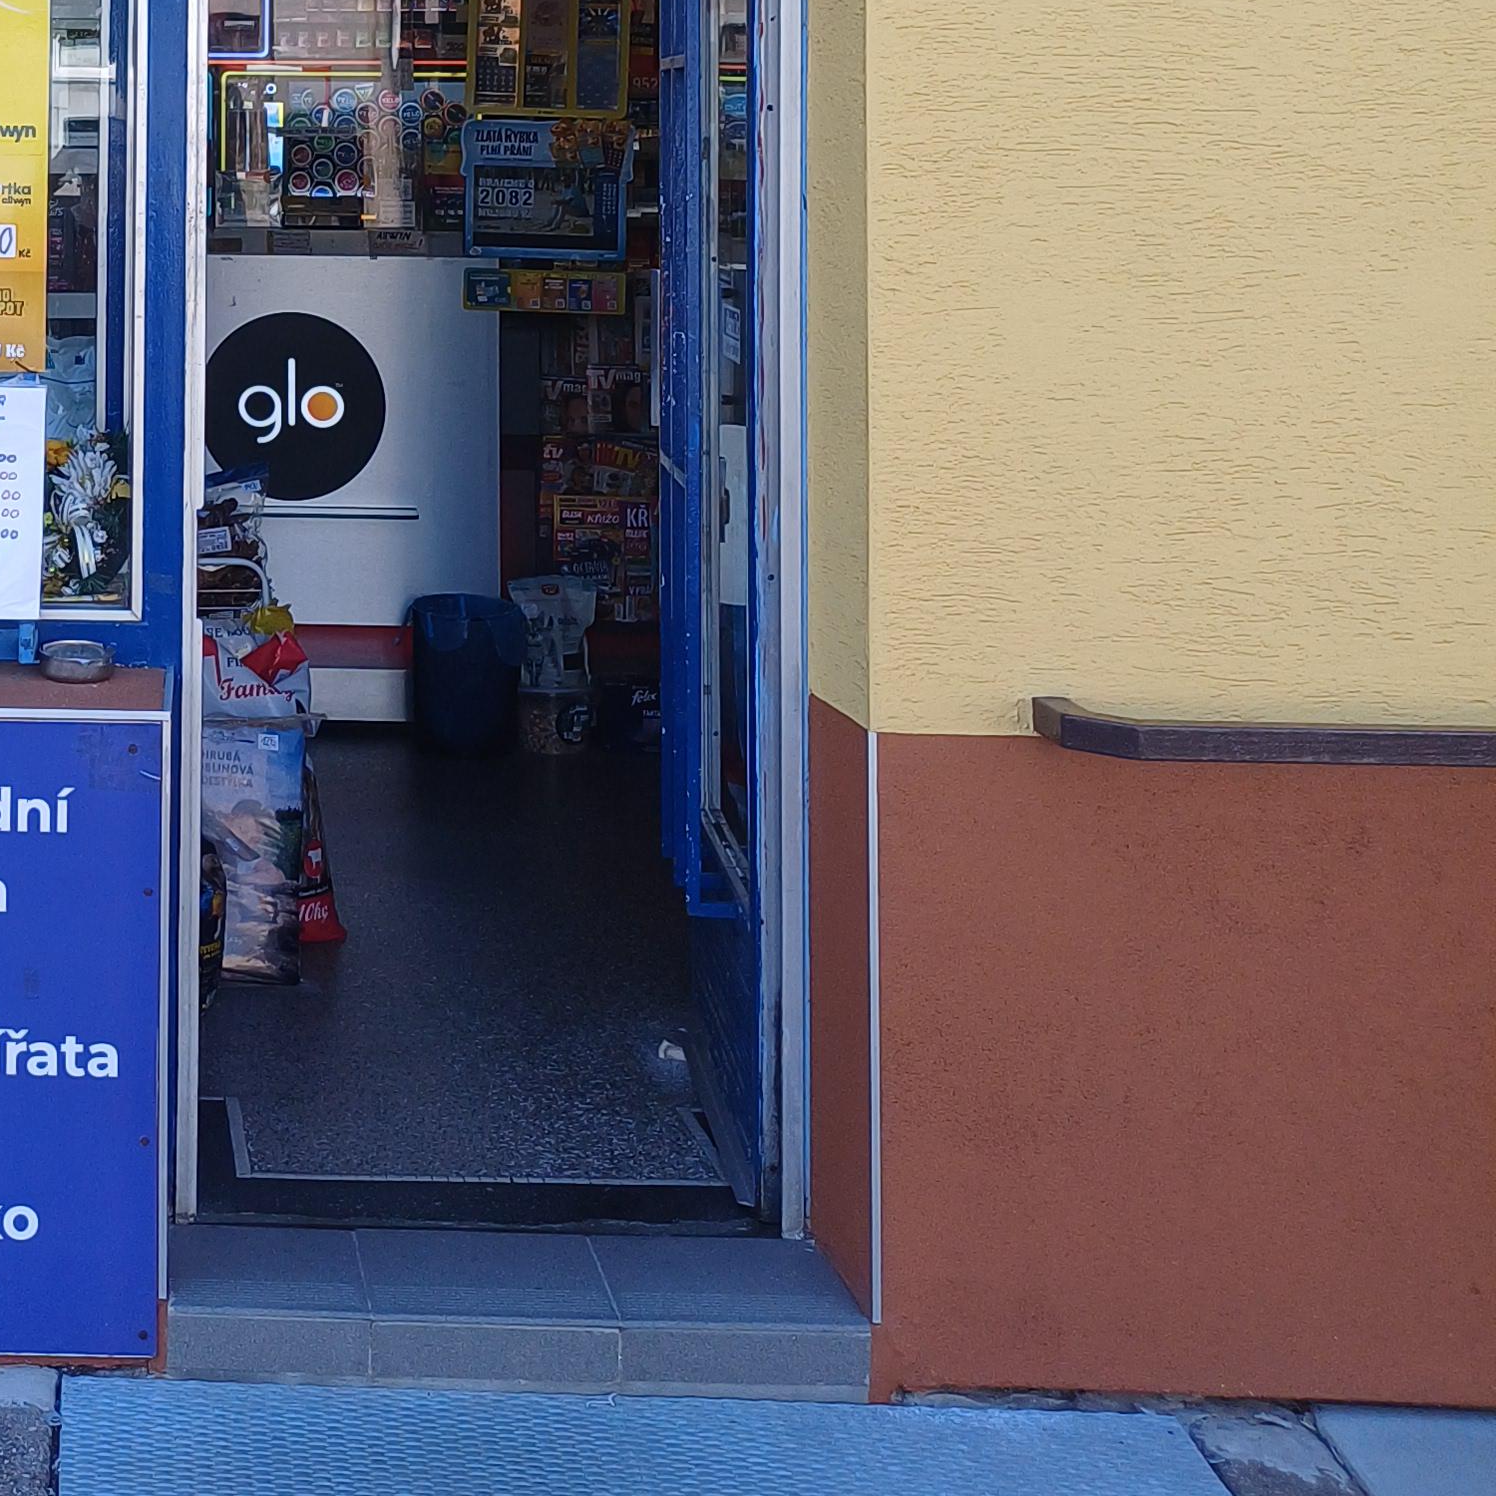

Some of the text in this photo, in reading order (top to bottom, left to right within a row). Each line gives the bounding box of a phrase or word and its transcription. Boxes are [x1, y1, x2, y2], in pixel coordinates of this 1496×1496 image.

[475, 128, 539, 144] ZLATÁ RYBKA
[1, 196, 32, 206] allwyn
[479, 188, 533, 206] 2082
[18, 249, 32, 258] Kč
[5, 343, 26, 358] Kč
[586, 369, 642, 390] TV mag
[238, 357, 345, 444] glo
